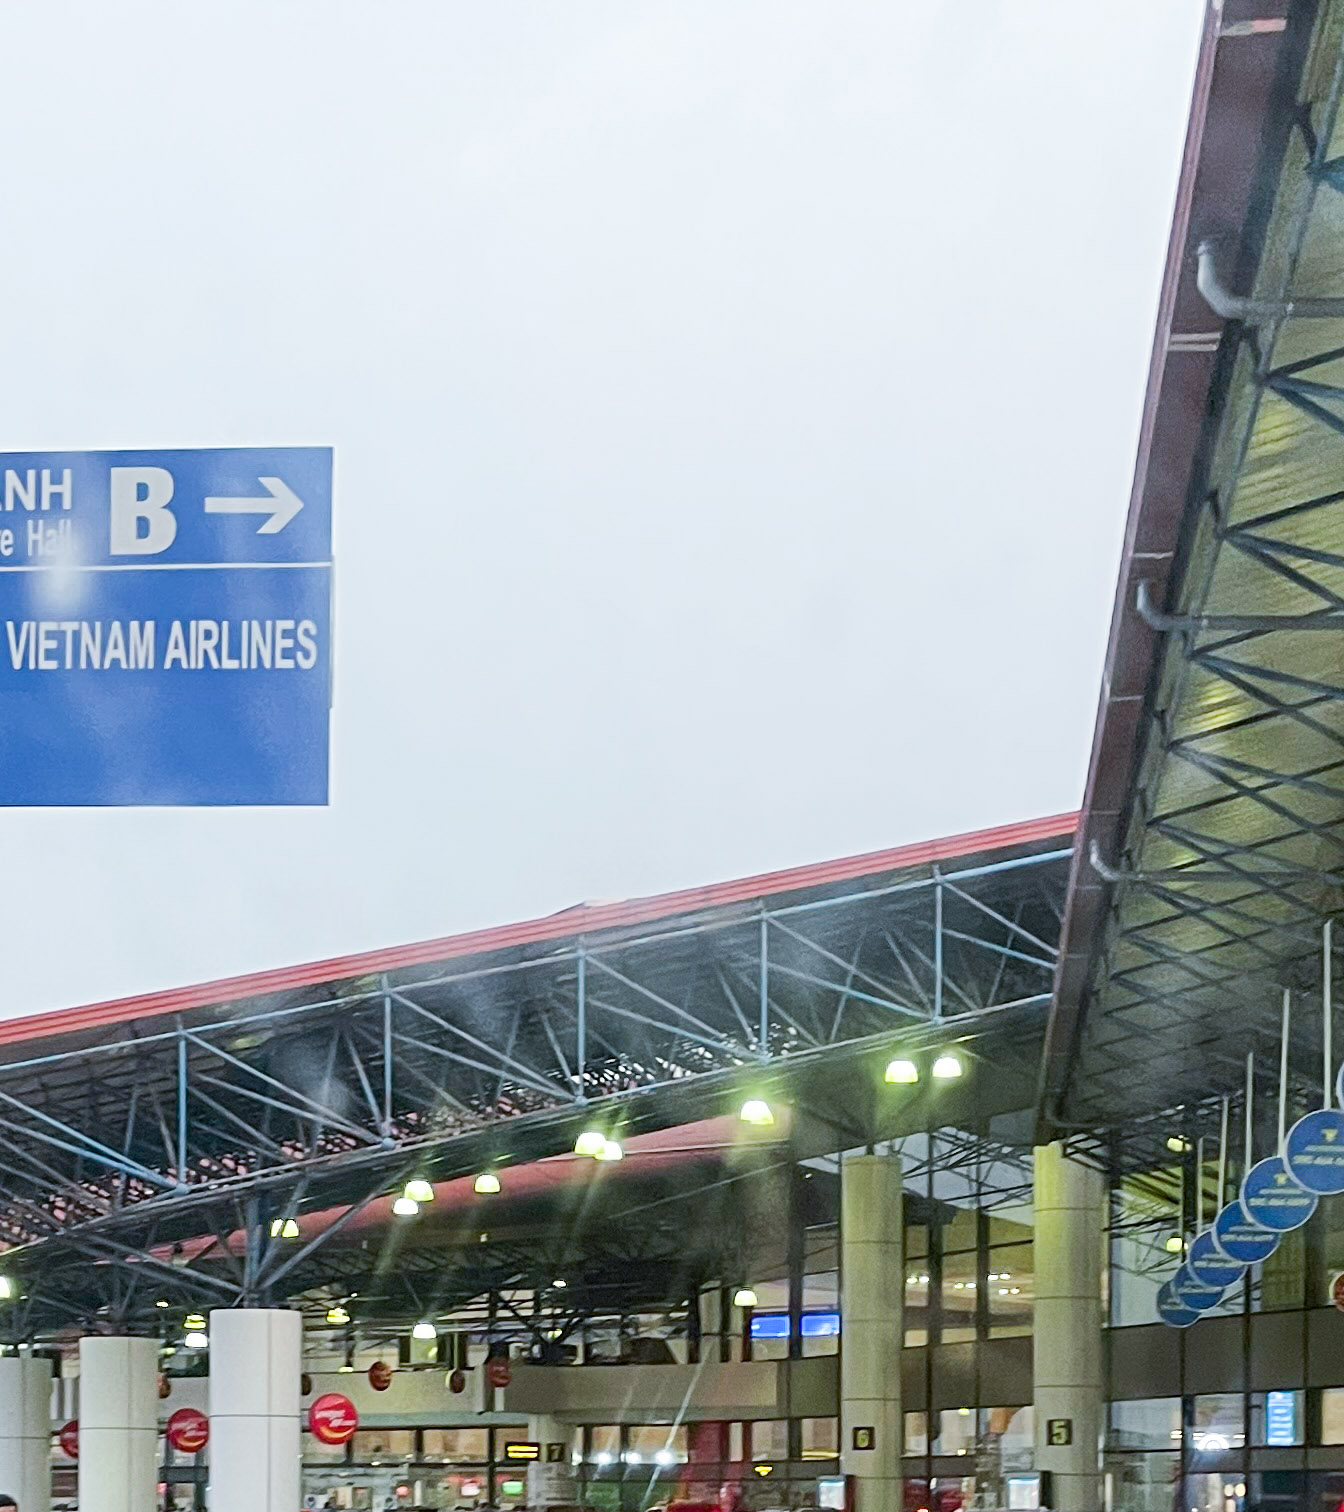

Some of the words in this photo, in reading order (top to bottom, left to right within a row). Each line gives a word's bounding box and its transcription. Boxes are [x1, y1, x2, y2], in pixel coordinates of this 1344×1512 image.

[110, 466, 177, 556] B
[6, 620, 155, 669] VIETNAM
[164, 619, 317, 669] AIRLINES
[1052, 1420, 1067, 1444] 5
